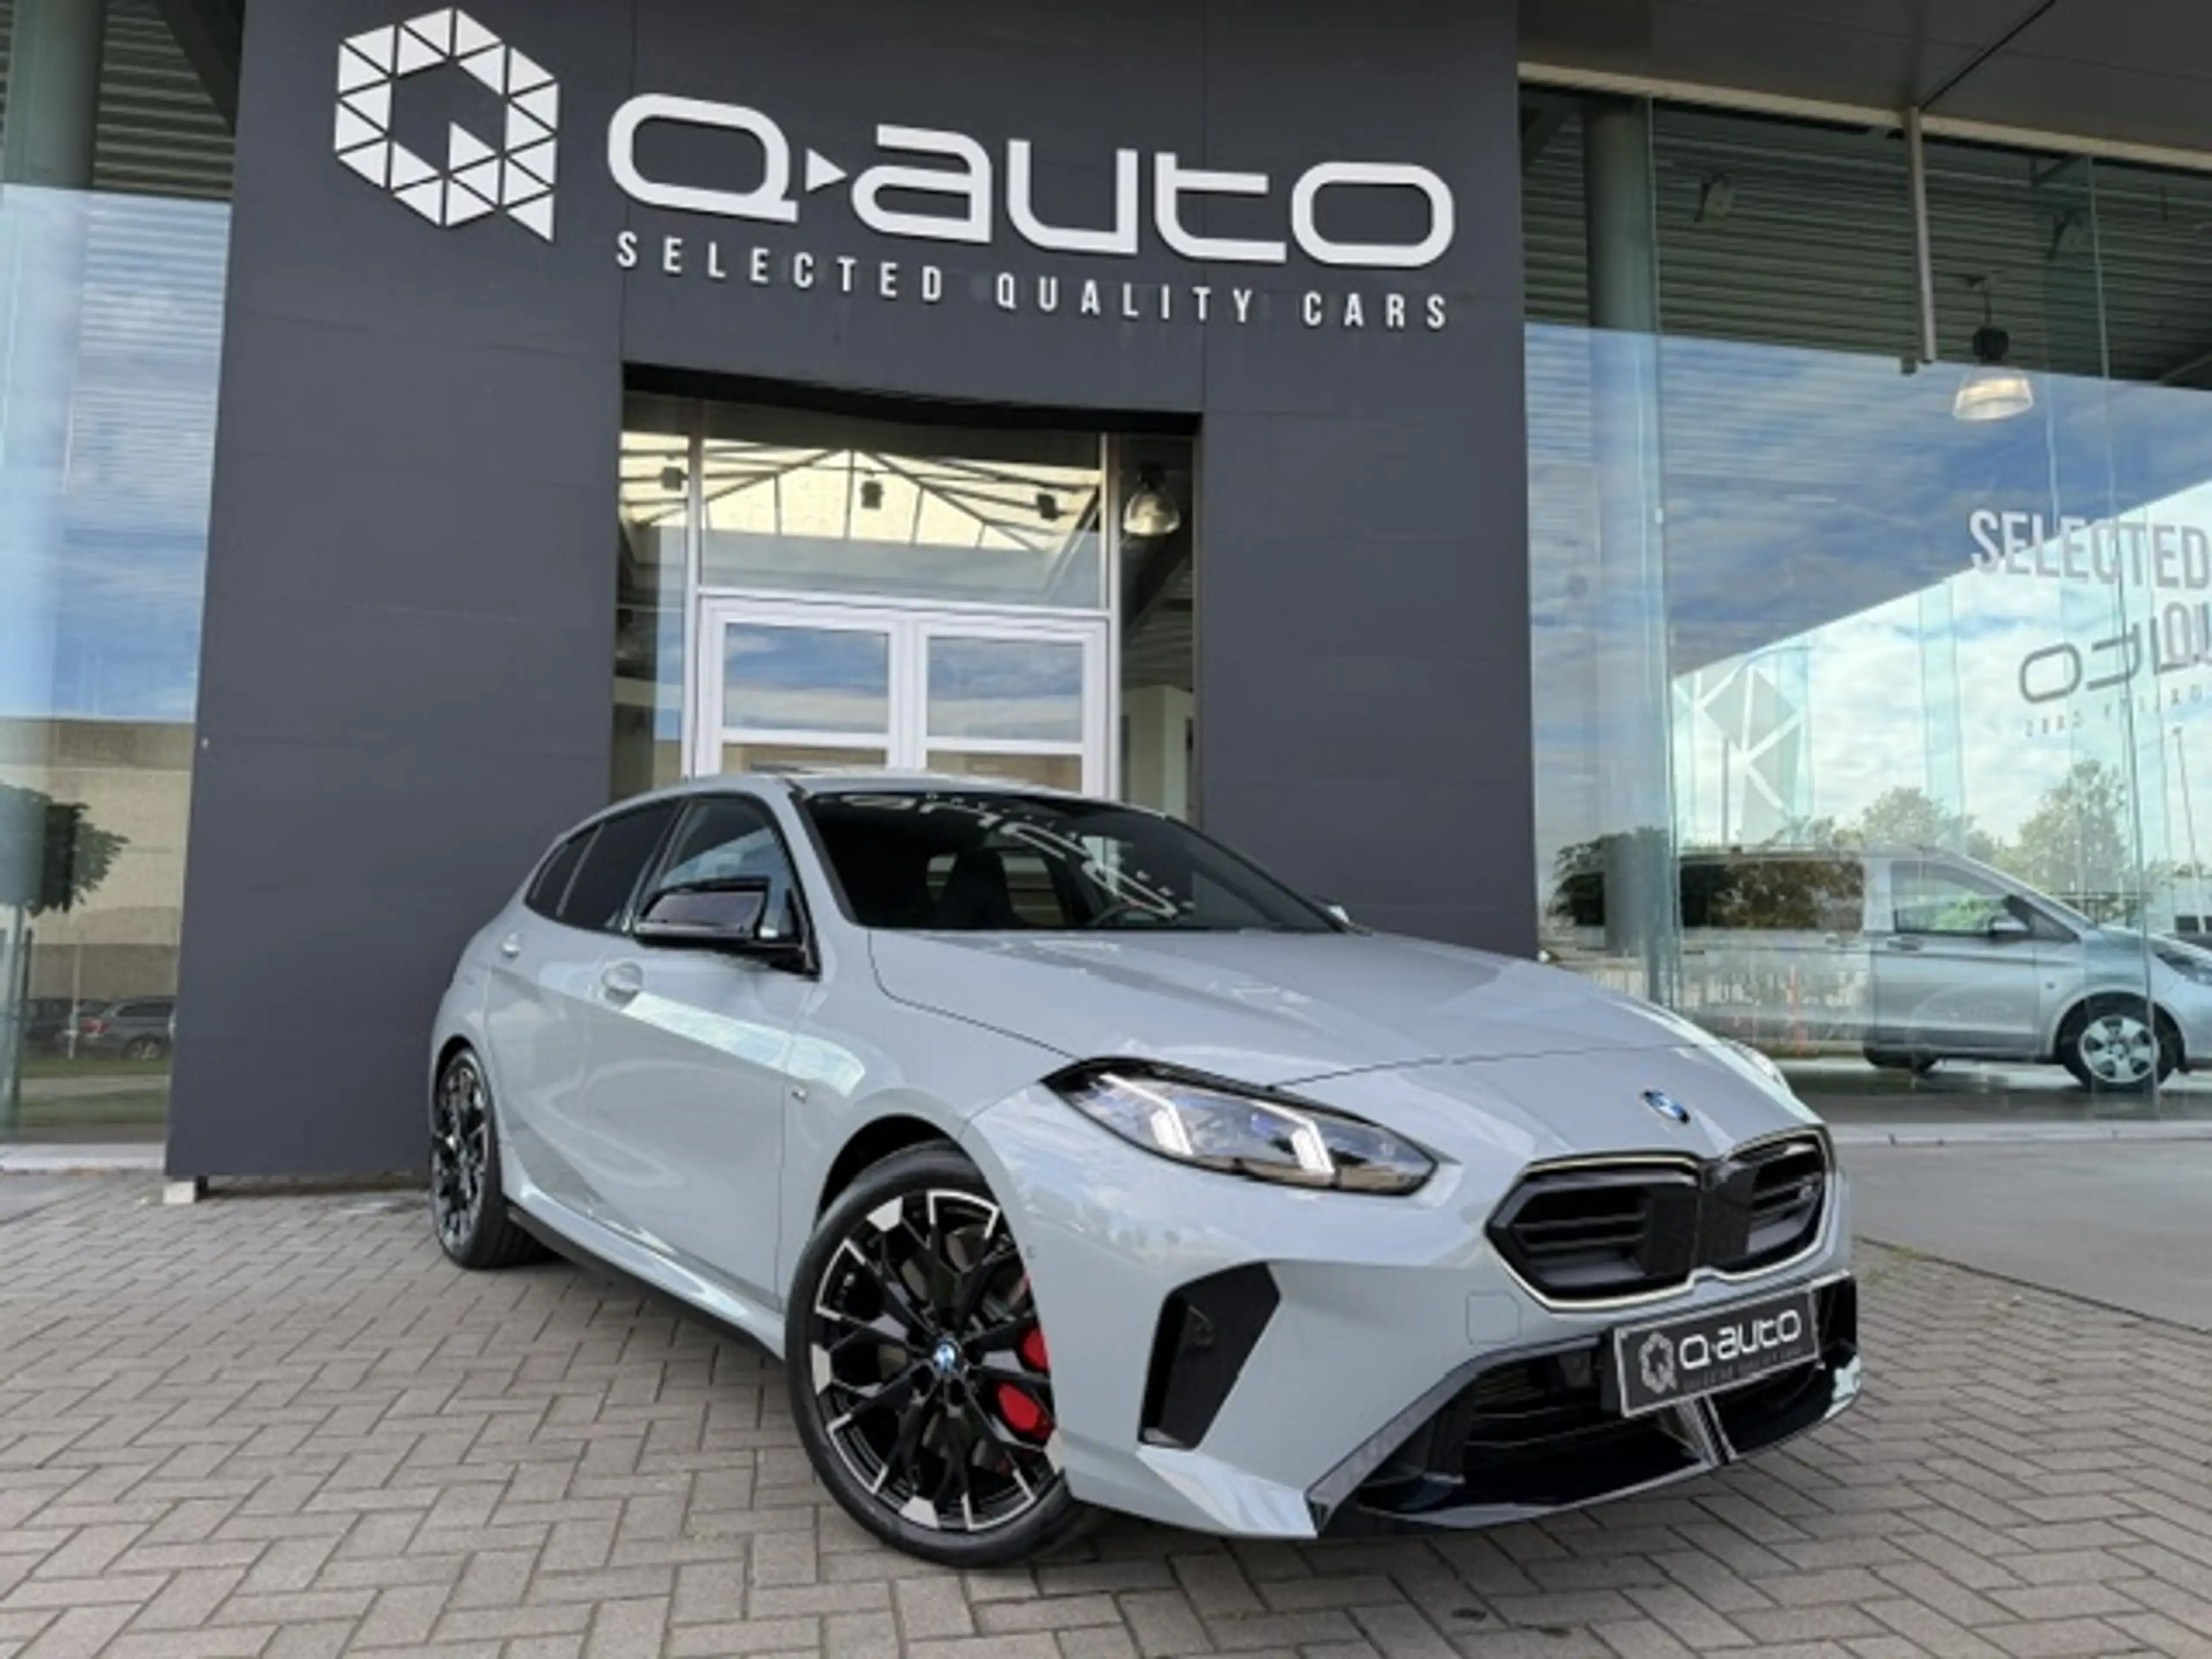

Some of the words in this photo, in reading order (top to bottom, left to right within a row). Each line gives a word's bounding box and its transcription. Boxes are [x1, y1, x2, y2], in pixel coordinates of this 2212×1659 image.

[616, 231, 941, 303] SELECTED
[997, 271, 1252, 323] QUALITY
[1304, 291, 1446, 328] CARS
[1969, 509, 2211, 590] SELECTED
